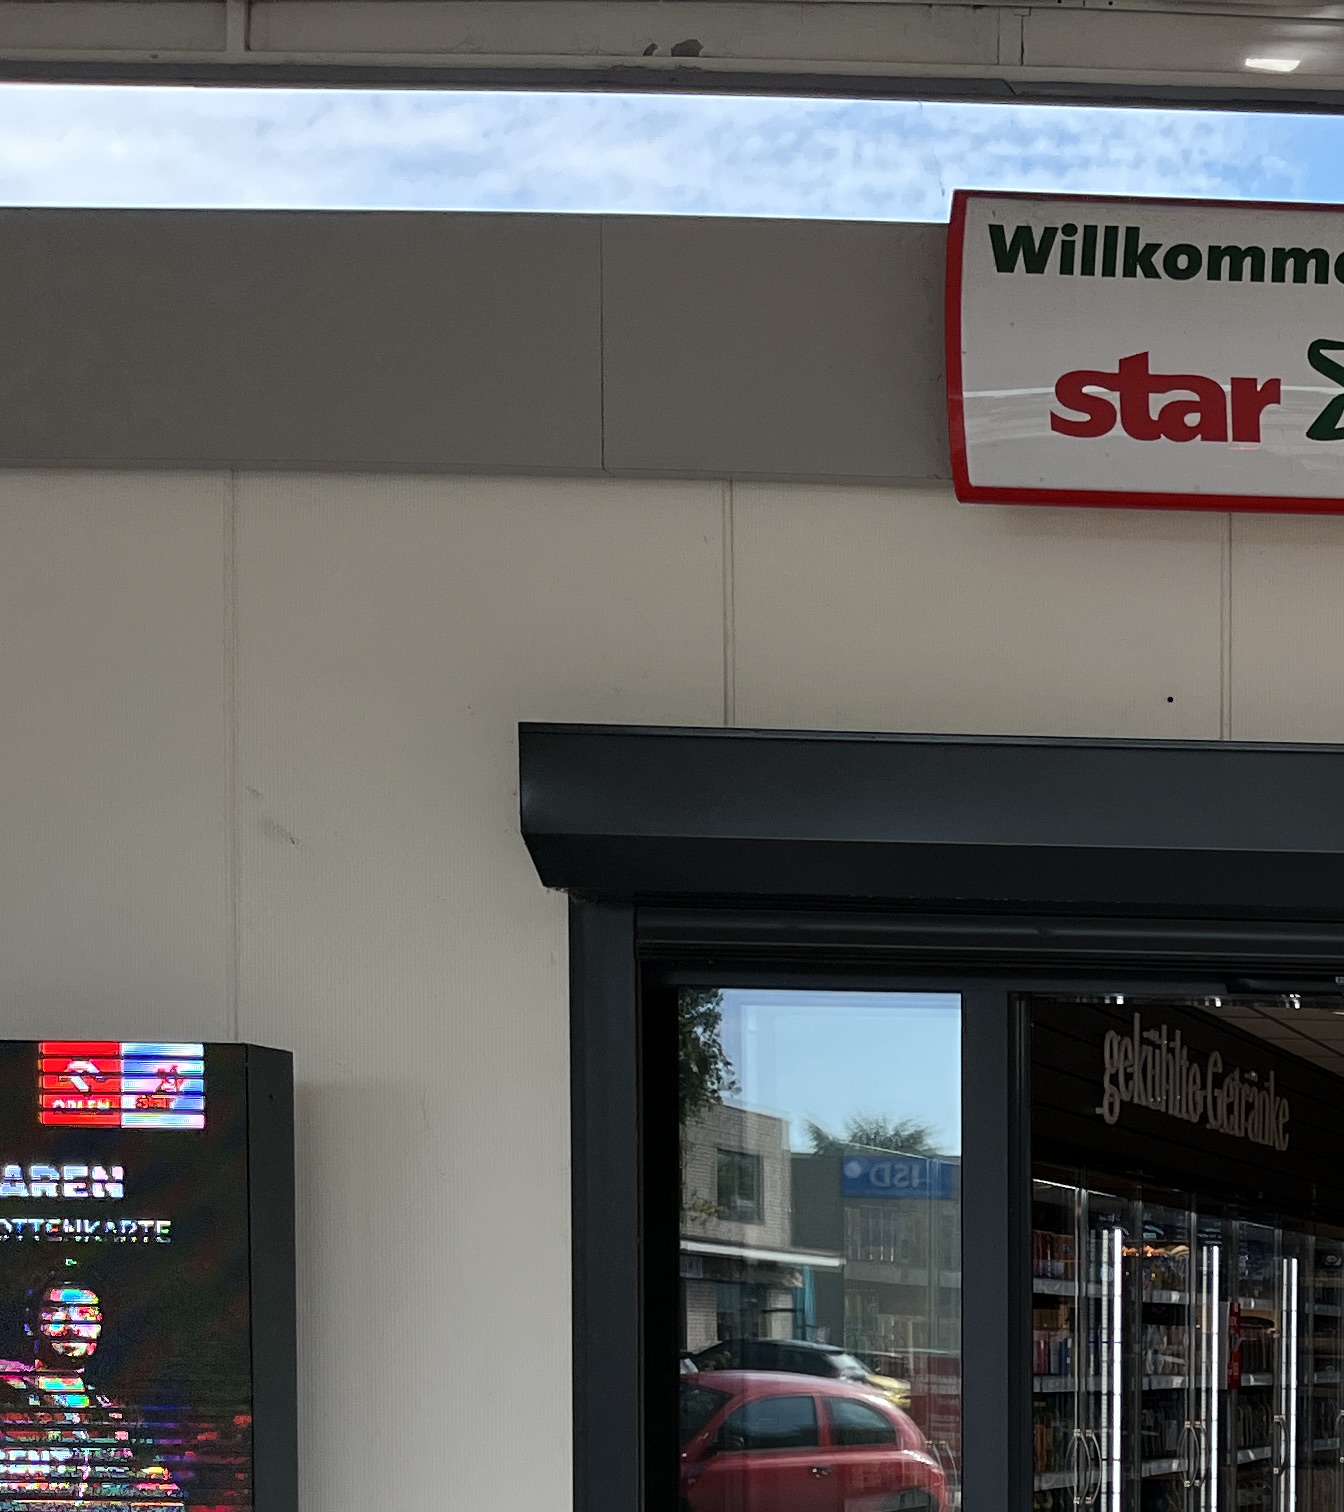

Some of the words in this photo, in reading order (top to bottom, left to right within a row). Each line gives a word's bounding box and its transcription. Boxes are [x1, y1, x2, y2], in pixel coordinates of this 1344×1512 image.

[1050, 351, 1281, 443] star
[1103, 1011, 1203, 1124] gekühlte
[1205, 1050, 1290, 1151] Getränke
